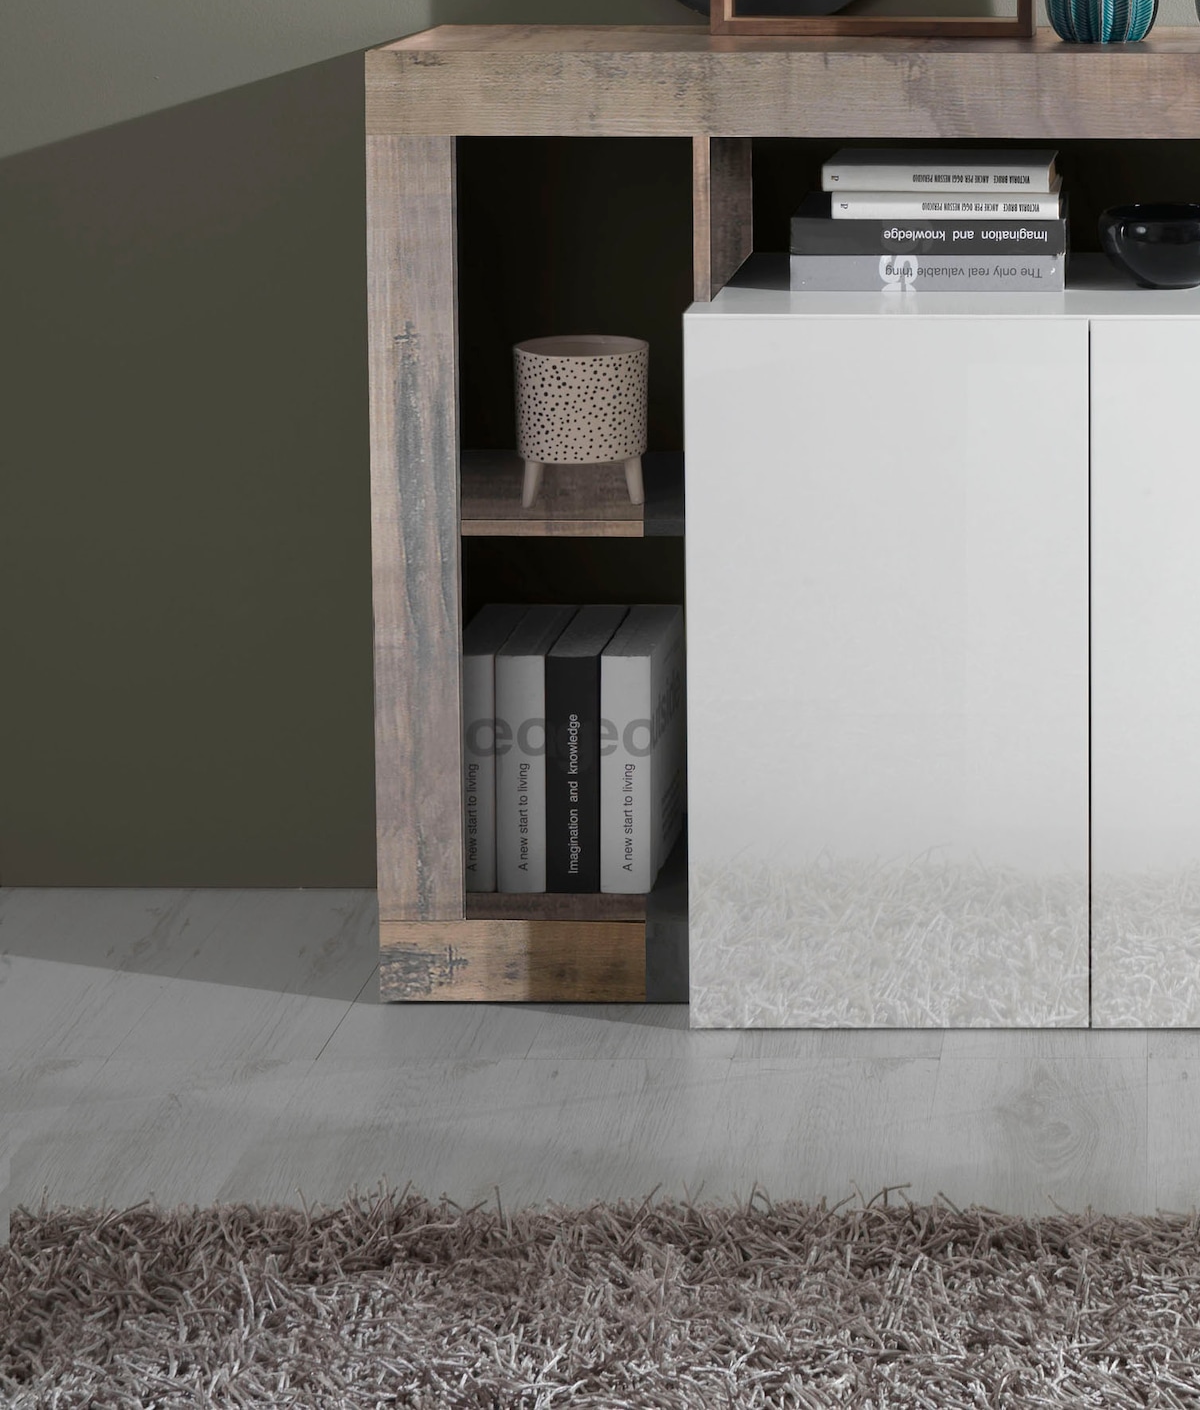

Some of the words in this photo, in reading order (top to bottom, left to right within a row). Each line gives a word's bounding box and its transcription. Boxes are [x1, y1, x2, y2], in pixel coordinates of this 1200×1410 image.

[883, 227, 945, 241] knowledge
[952, 230, 975, 241] and
[981, 229, 1048, 242] Imagination
[885, 264, 913, 276] thing
[917, 266, 964, 277] valuable
[968, 266, 989, 277] real
[992, 264, 1017, 276] only
[1021, 267, 1043, 278] The
[567, 713, 581, 775] knowledge
[518, 763, 531, 792] living
[622, 763, 636, 792] living
[567, 781, 579, 802] and
[519, 795, 528, 808] to
[623, 795, 633, 808] to
[519, 809, 528, 834] start
[623, 809, 633, 834] start
[568, 809, 581, 874] Imagination
[520, 837, 529, 861] new
[624, 837, 633, 861] new
[518, 863, 529, 871] A
[622, 862, 633, 871] A
